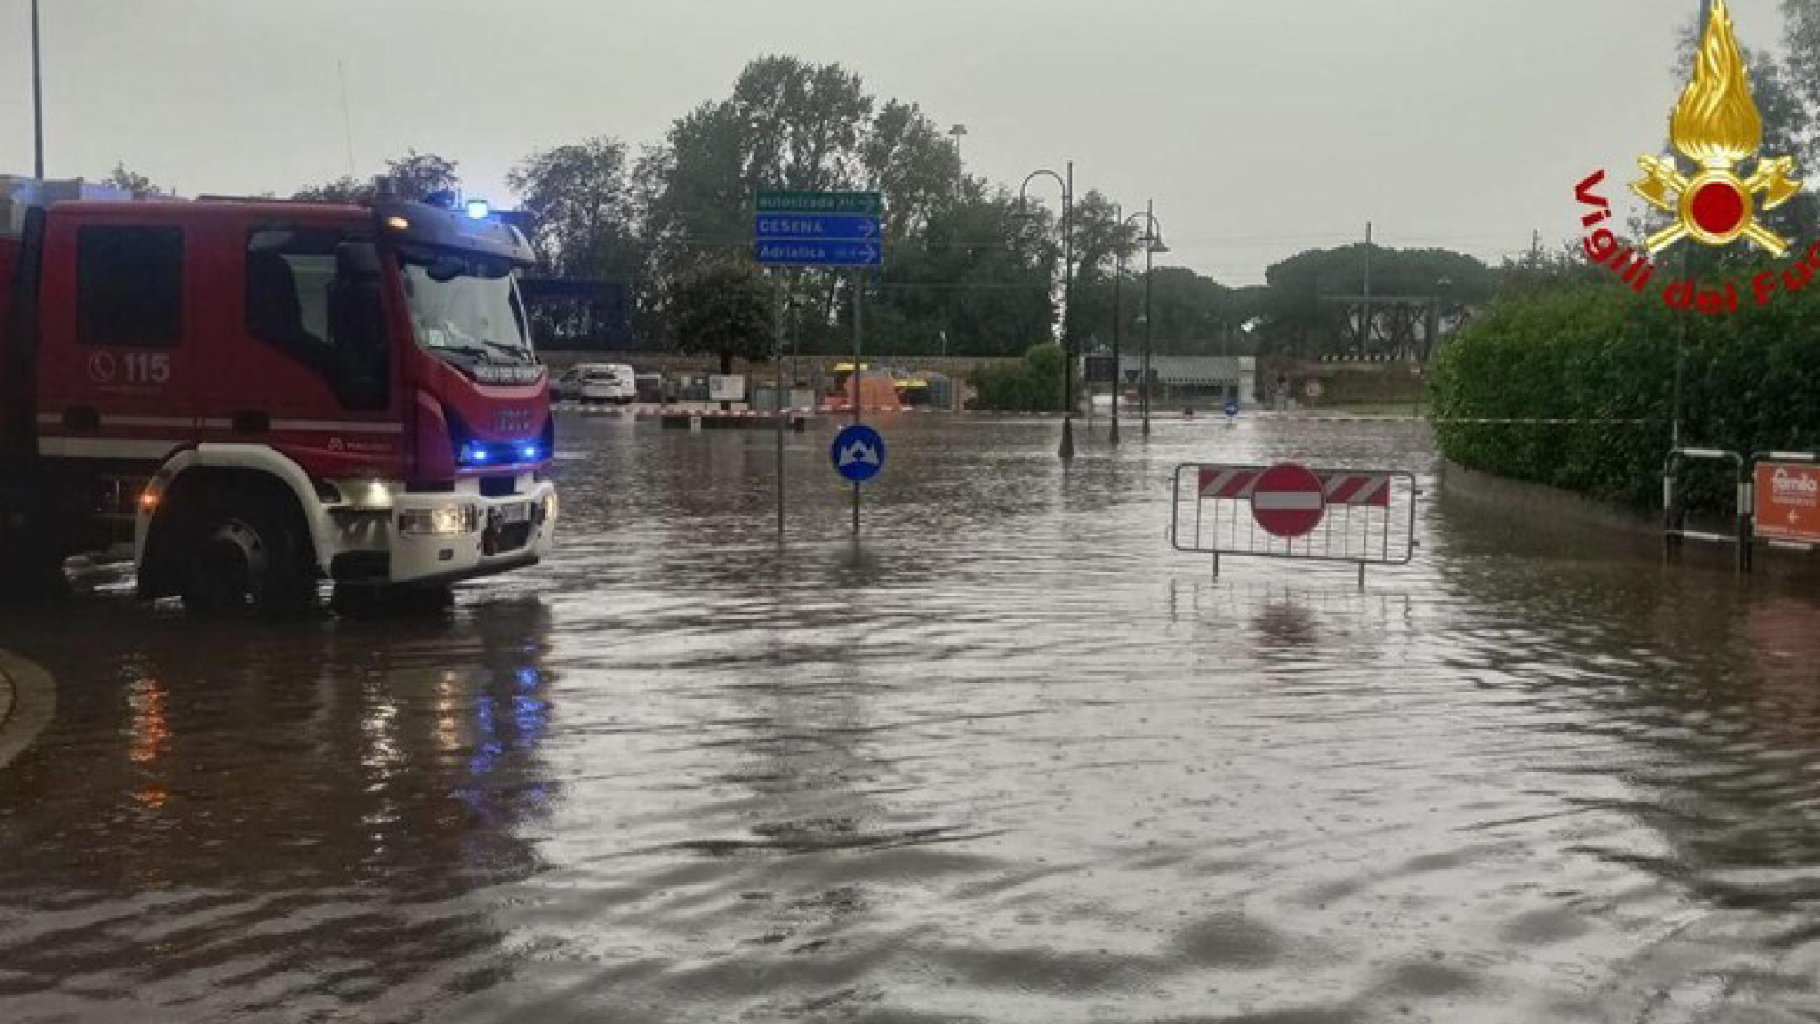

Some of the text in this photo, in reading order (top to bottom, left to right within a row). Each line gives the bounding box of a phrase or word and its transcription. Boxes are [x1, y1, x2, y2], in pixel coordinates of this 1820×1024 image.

[760, 219, 823, 233] CESENA
[760, 245, 826, 258] Adriatica
[123, 352, 170, 383] 115
